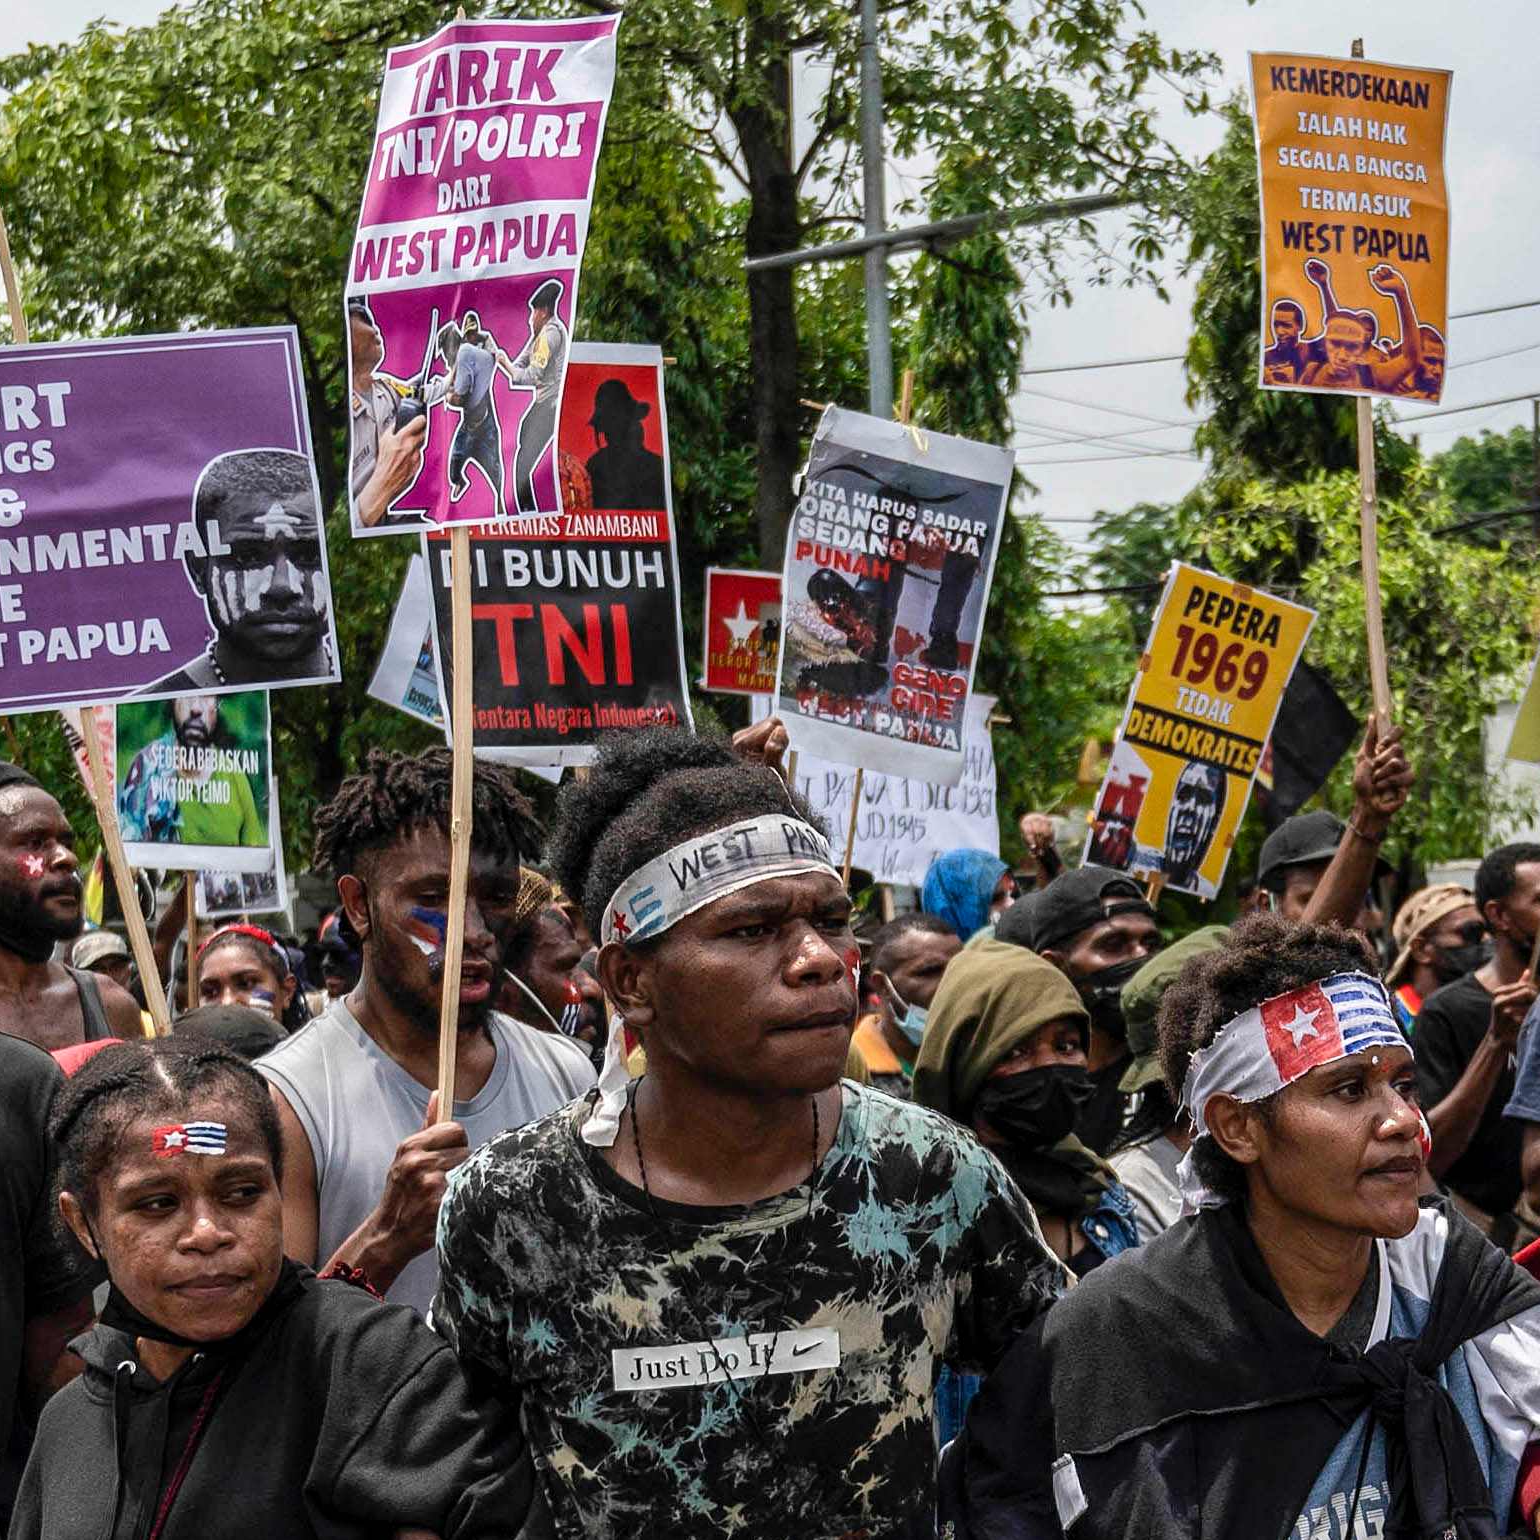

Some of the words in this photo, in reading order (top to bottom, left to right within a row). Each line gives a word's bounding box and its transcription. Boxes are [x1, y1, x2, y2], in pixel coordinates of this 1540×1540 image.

[410, 48, 564, 116] TARIK
[1270, 65, 1430, 109] KEMERDEKAAN
[378, 111, 586, 182] TNI/POLRI
[1297, 111, 1363, 138] IALAH
[1366, 119, 1408, 145] HAK
[1277, 146, 1350, 172] SEGALA
[1355, 154, 1429, 184] BANGSA
[436, 174, 491, 213] DARI
[1299, 187, 1412, 219] TERMASUK
[353, 228, 447, 283] WEST
[452, 213, 579, 270] PAPUA
[1281, 220, 1345, 254] WEST
[1353, 225, 1432, 263] PAPUA
[563, 514, 659, 538] ZANAMBANI
[799, 494, 890, 534] ORANG
[806, 480, 846, 506] KITA
[852, 490, 917, 520] HARUS
[922, 509, 988, 537] SADAR
[797, 516, 907, 562] SEDANG
[503, 549, 665, 589] BUNUH
[795, 540, 892, 583] PUNAH
[1182, 585, 1282, 648] PEPERA
[19, 616, 171, 664] PAPUA
[471, 604, 635, 687] TNI
[892, 661, 968, 697] GENO
[1170, 624, 1270, 702] 1969
[534, 702, 592, 734] Negara
[1174, 685, 1235, 725] TIDAK
[1126, 709, 1261, 775] DEMOKRATIS
[194, 779, 231, 805] YEIMO
[669, 825, 760, 891] WEST
[630, 1354, 691, 1382] Just
[696, 1348, 740, 1377] Do
